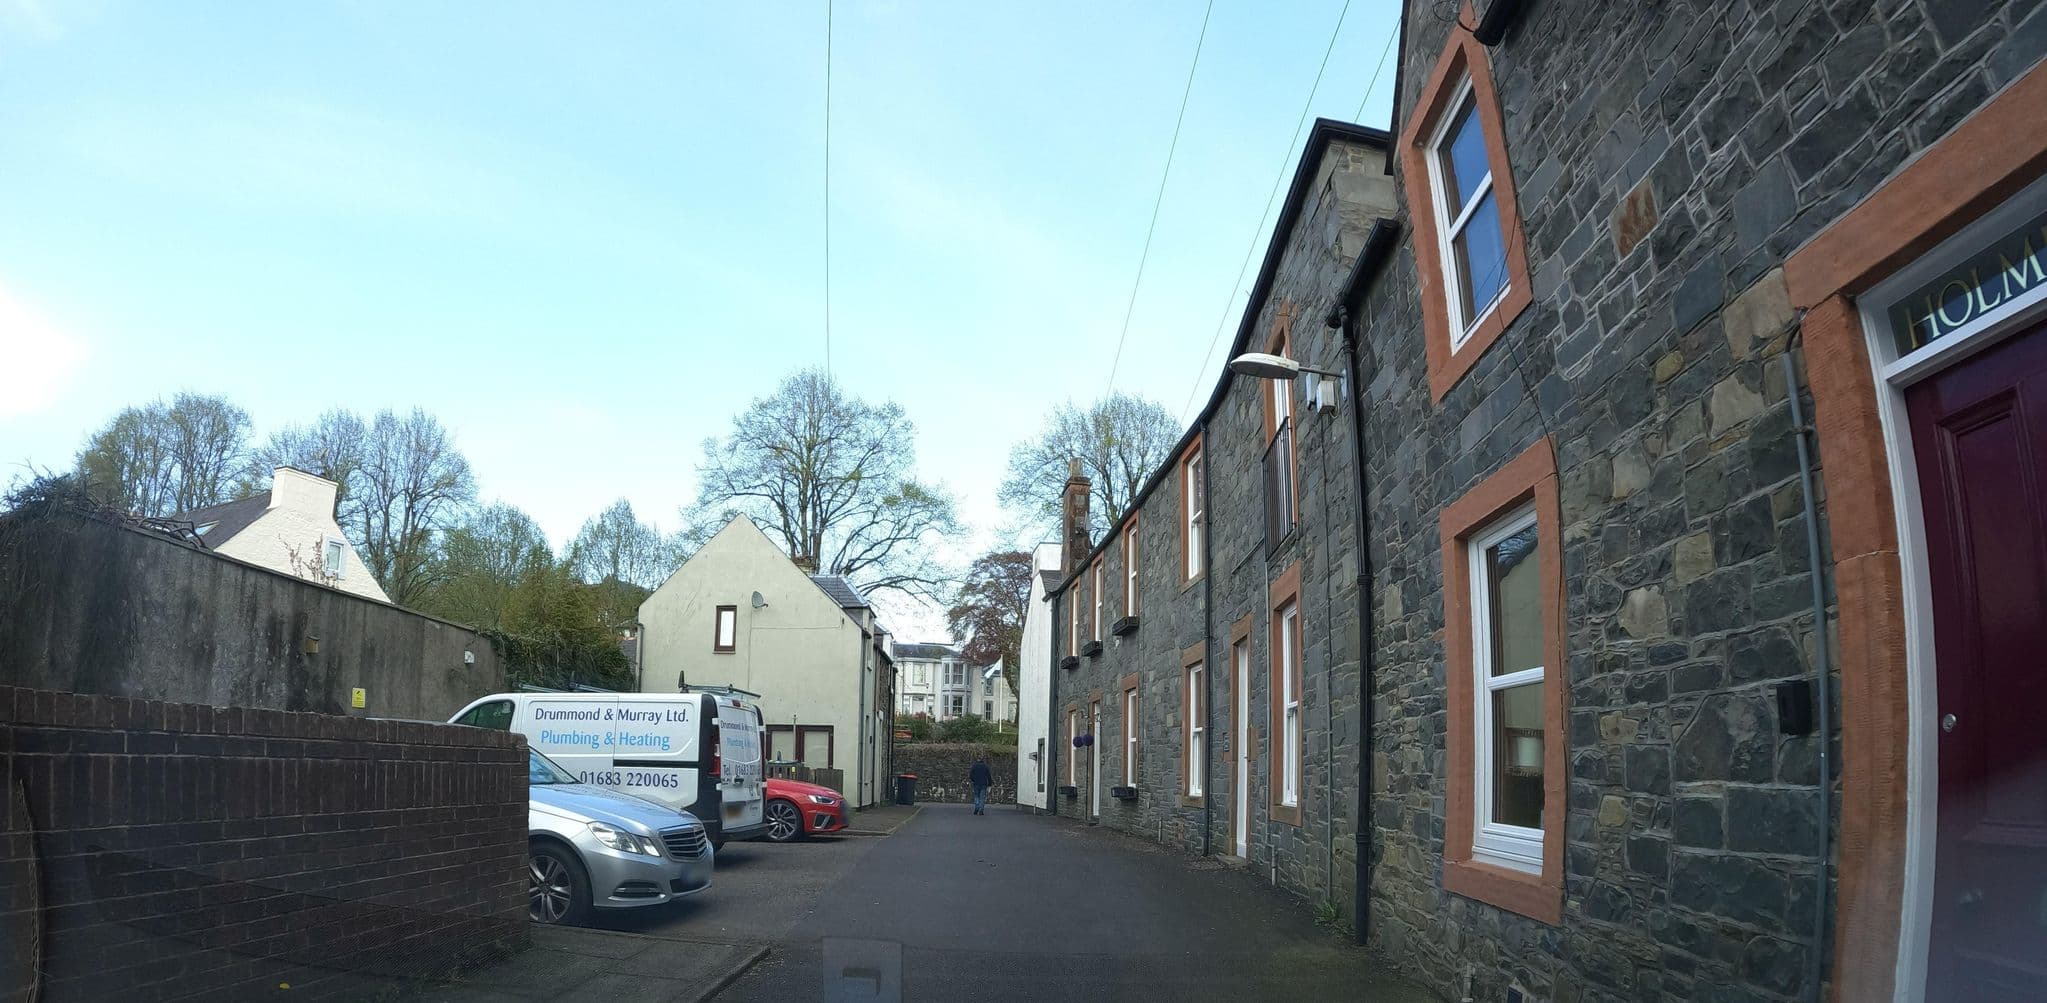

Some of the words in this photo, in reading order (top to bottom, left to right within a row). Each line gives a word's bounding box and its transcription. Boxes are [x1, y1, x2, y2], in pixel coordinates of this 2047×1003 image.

[535, 707, 601, 721] Drummond
[603, 708, 614, 721] &
[617, 708, 662, 725] Murray
[666, 708, 689, 723] Ltd.
[541, 730, 600, 749] Plumbing
[603, 731, 615, 746] &
[619, 732, 670, 751] Heating
[580, 770, 621, 786] 01683
[626, 772, 679, 788] 220065
